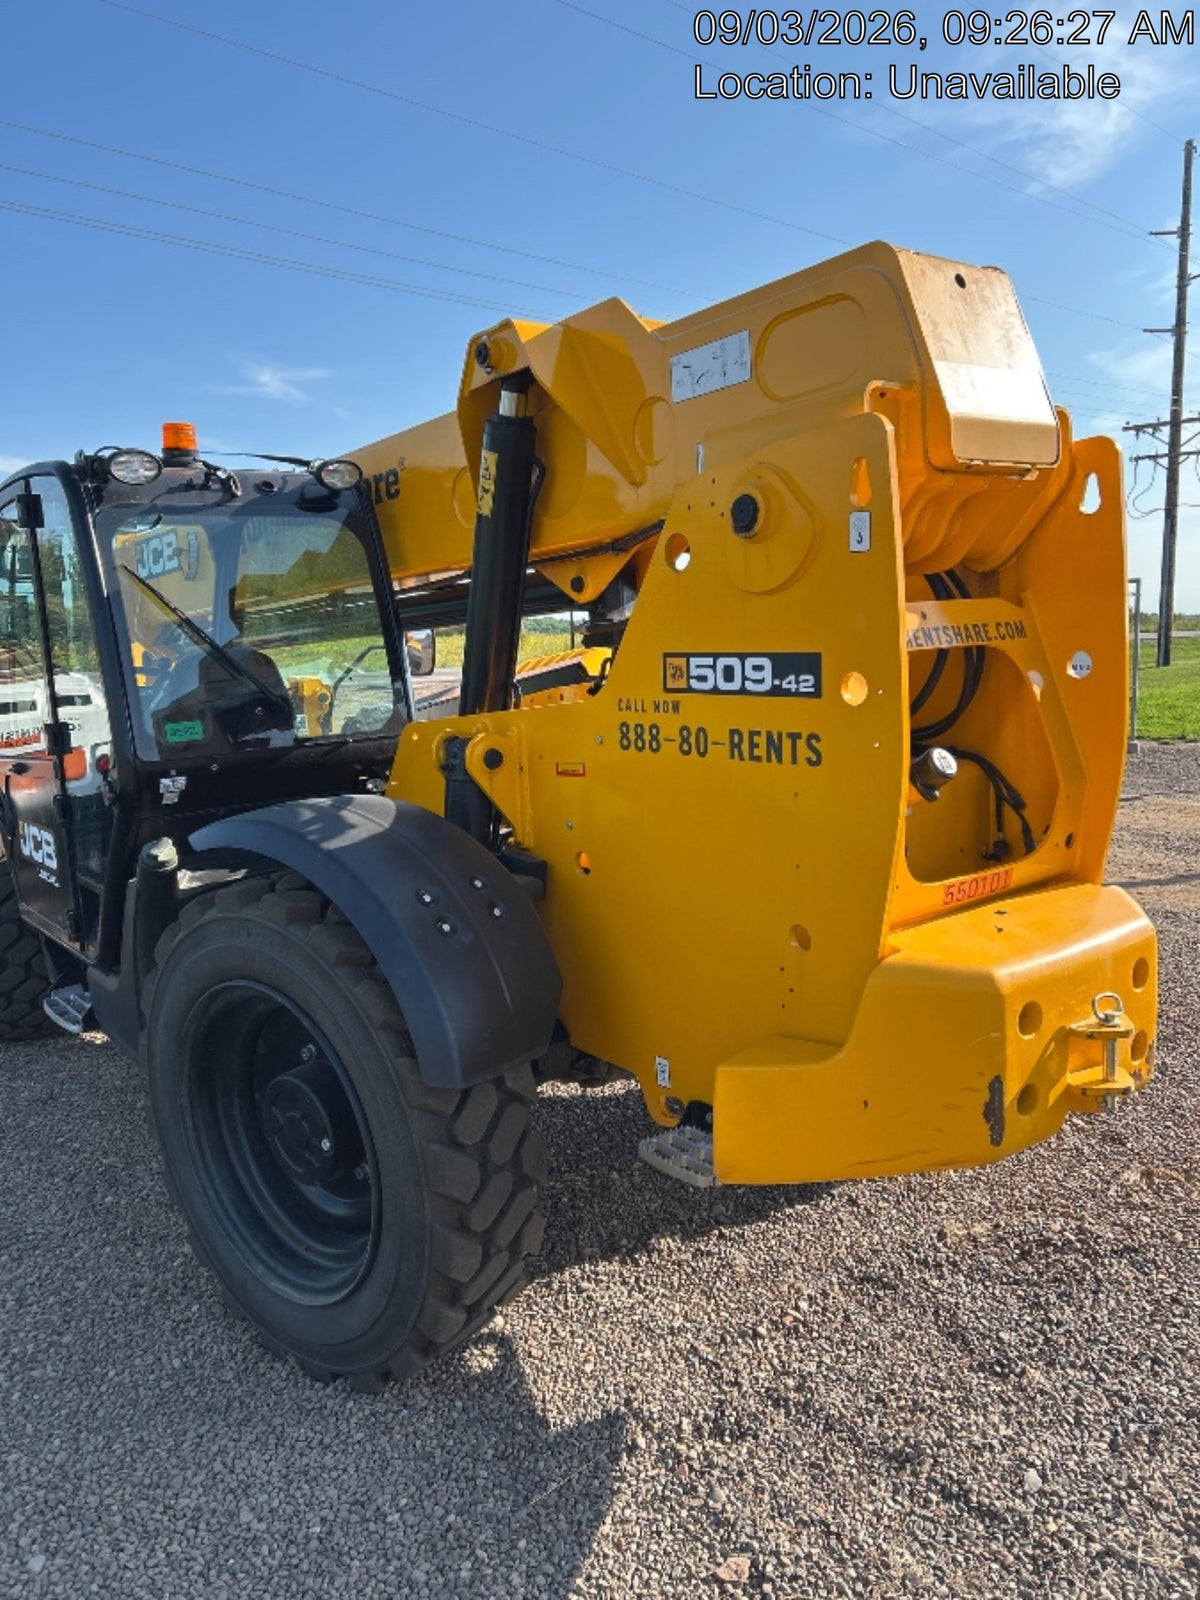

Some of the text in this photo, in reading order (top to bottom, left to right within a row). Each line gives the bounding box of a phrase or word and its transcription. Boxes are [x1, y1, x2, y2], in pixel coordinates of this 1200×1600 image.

[137, 532, 179, 579] JCB
[688, 656, 815, 692] 509-42
[617, 698, 681, 714] CALL NOW
[618, 721, 823, 768] 888-80-RENTS
[20, 822, 58, 871] JCB
[943, 868, 1013, 907] 550101
